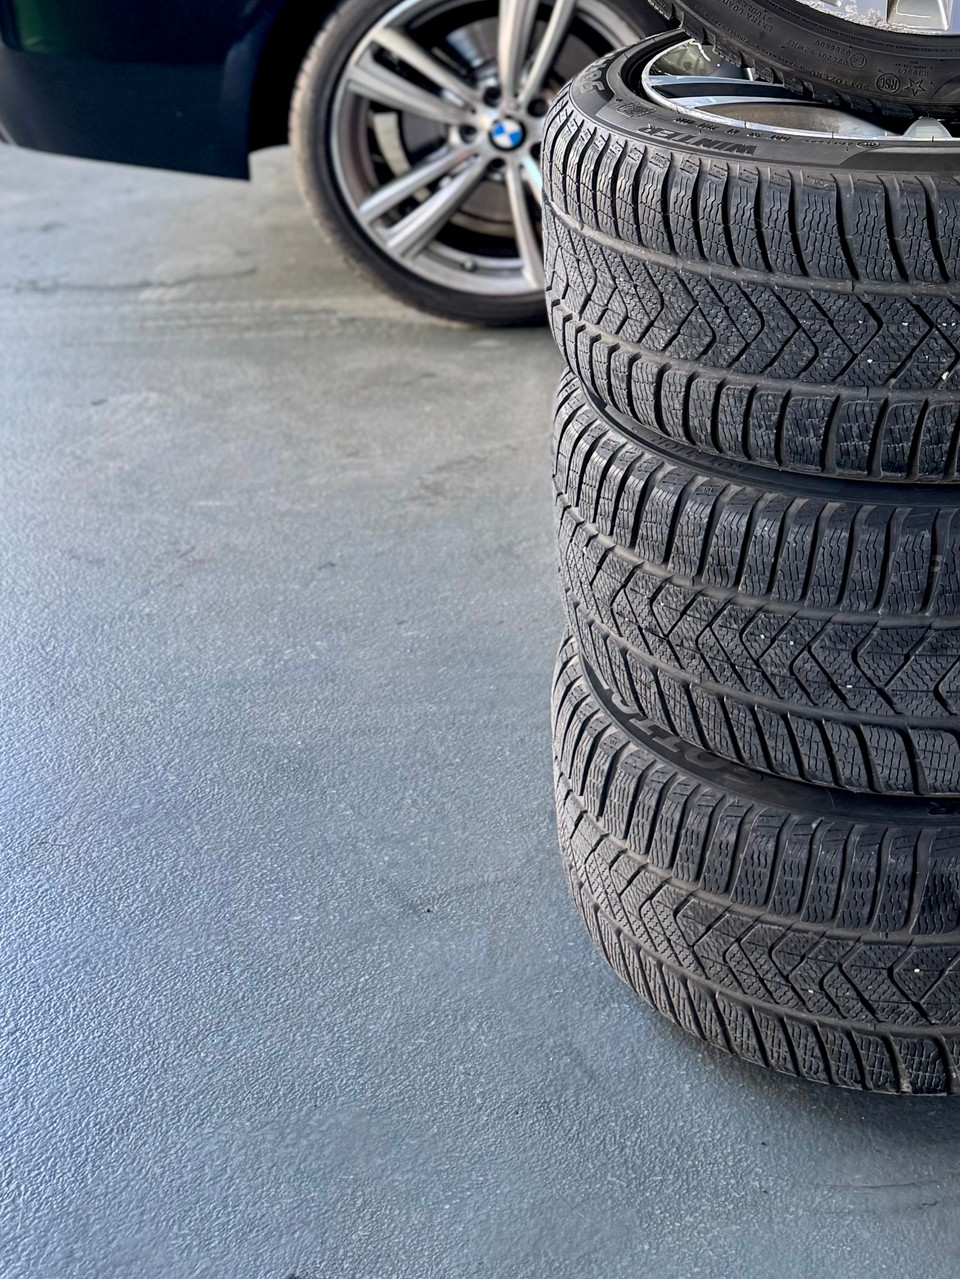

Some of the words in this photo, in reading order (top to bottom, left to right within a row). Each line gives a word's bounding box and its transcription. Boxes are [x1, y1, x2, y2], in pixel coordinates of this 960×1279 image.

[744, 11, 773, 32] EXTRA
[808, 68, 870, 91] SOTTOZERO
[637, 123, 758, 156] WINTER
